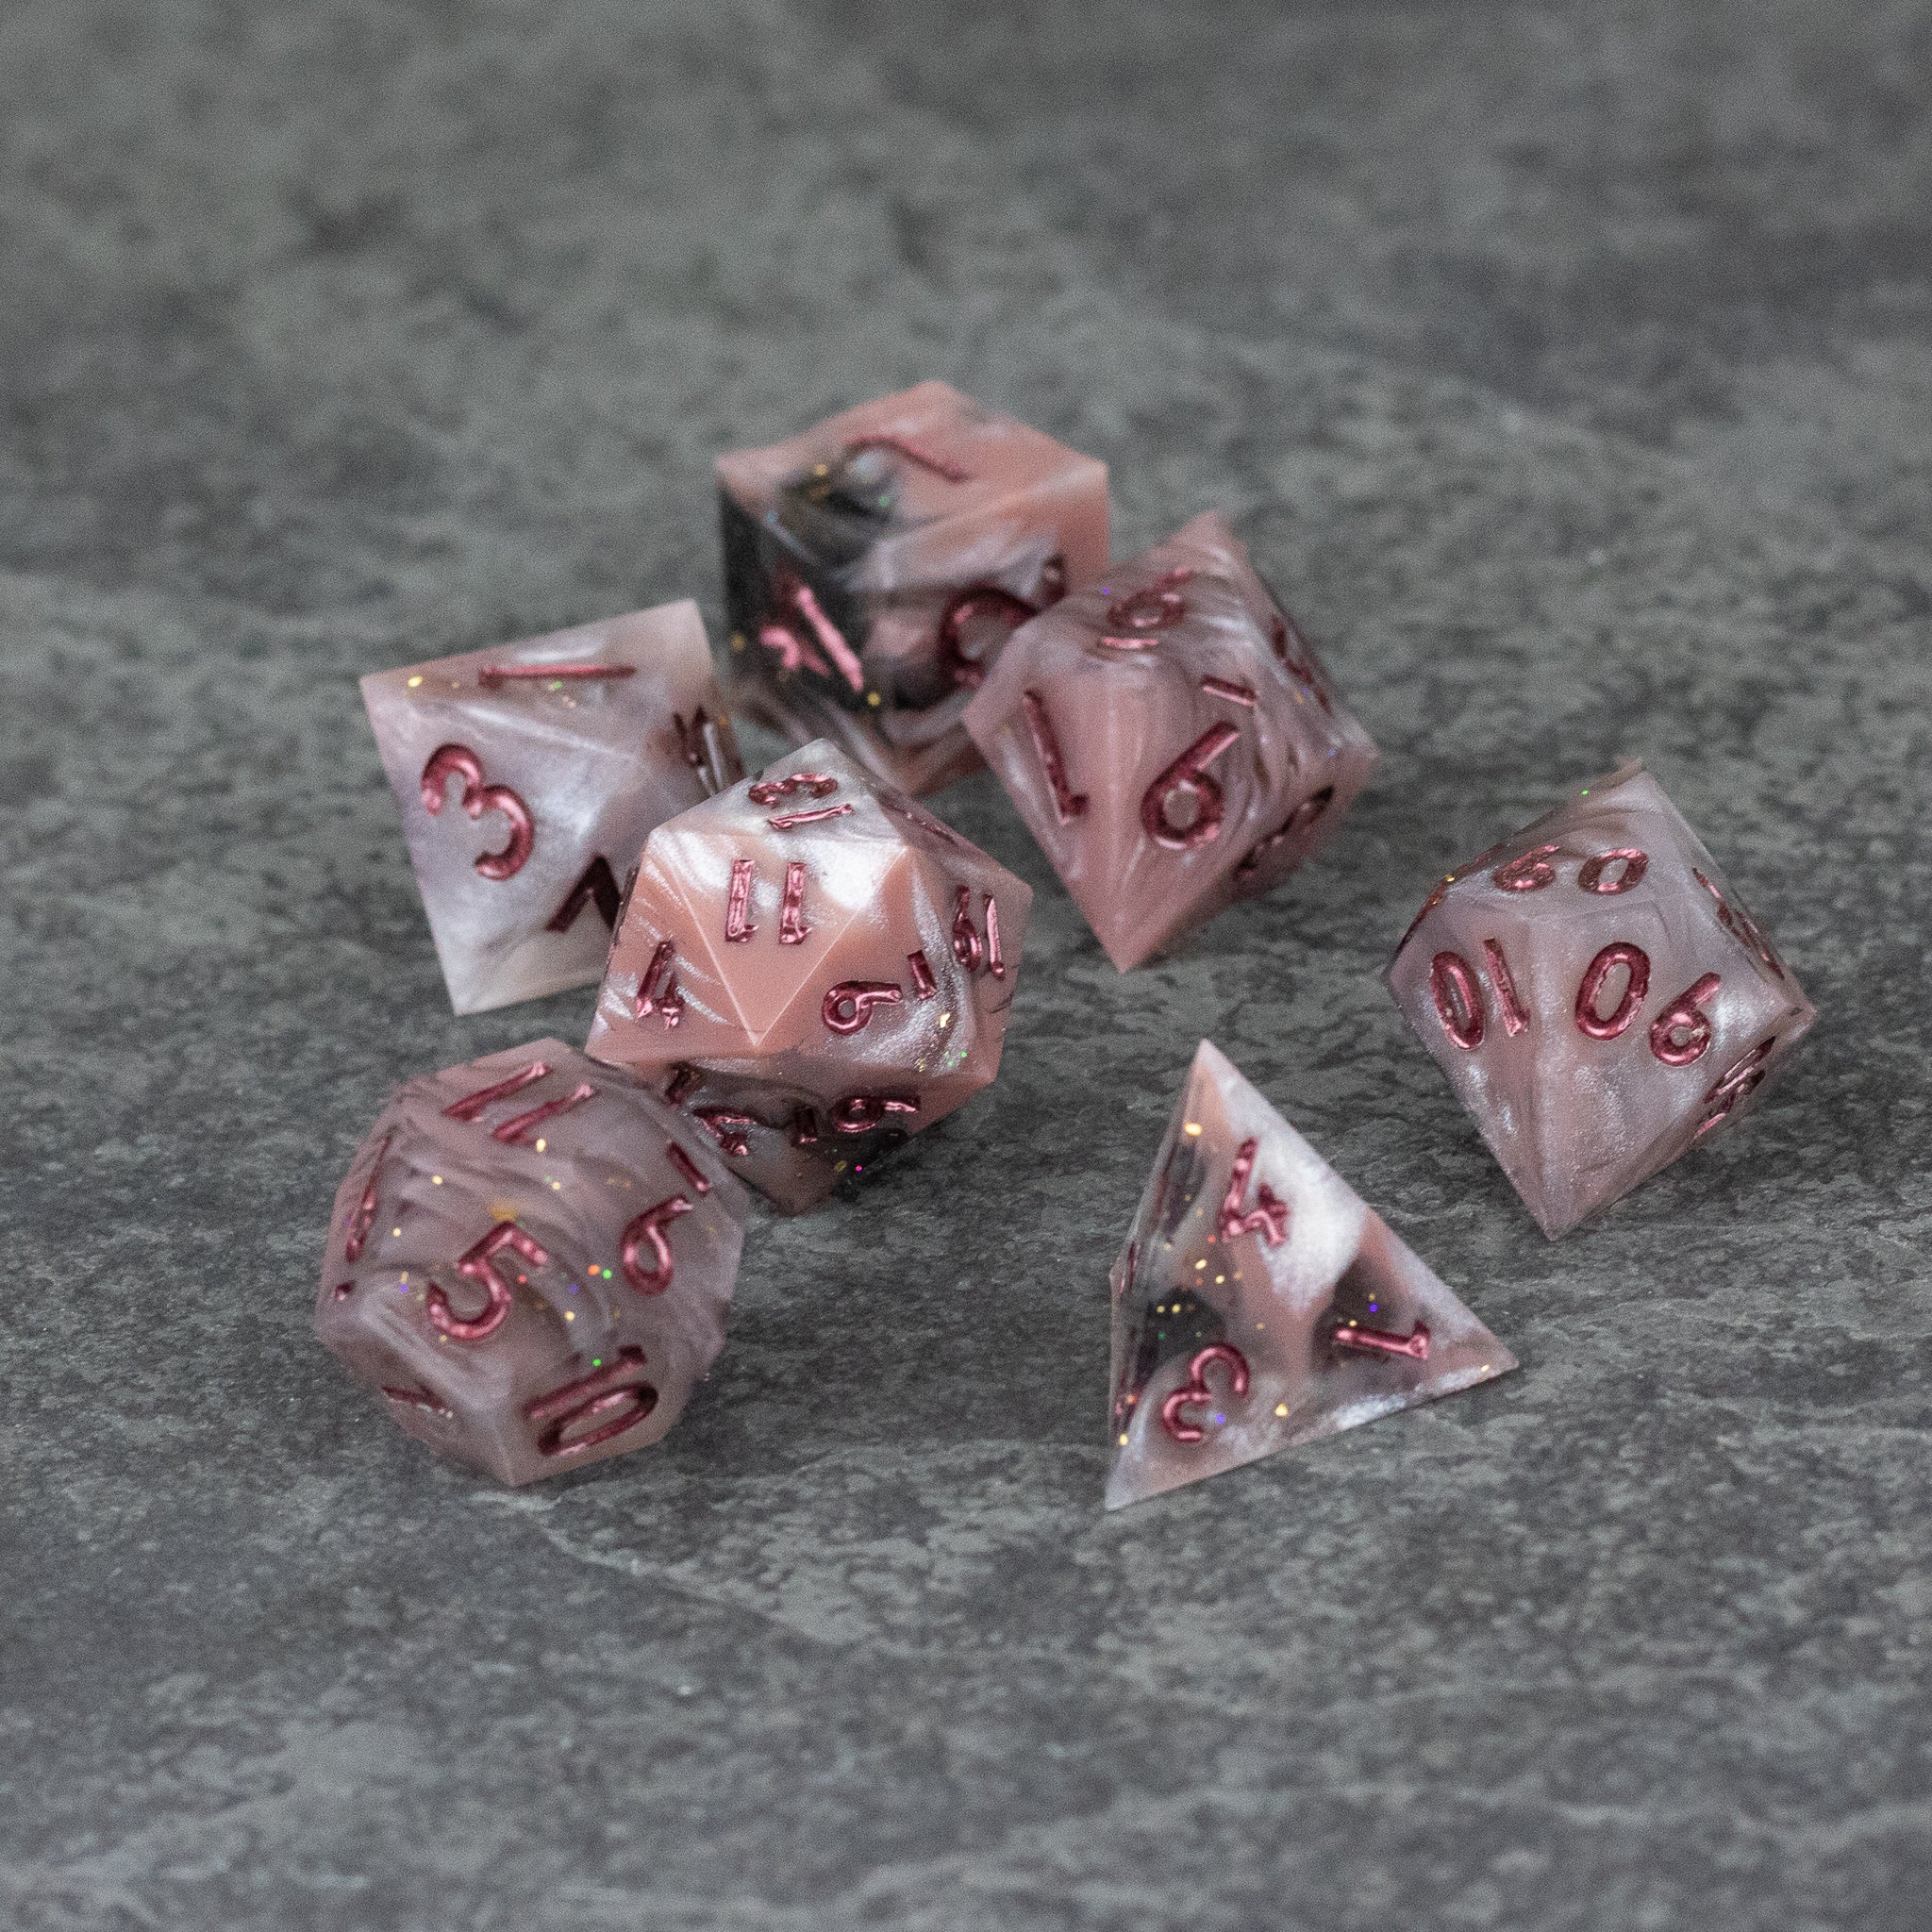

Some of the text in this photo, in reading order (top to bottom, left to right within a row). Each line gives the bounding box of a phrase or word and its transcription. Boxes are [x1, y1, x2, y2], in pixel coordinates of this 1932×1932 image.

[421, 742, 536, 882] 3
[724, 858, 813, 945] 11
[1221, 1136, 1289, 1249] 4
[424, 1220, 549, 1341] 5
[1161, 1342, 1252, 1443] 3
[1334, 1321, 1431, 1361] 1
[522, 1344, 659, 1457] 10
